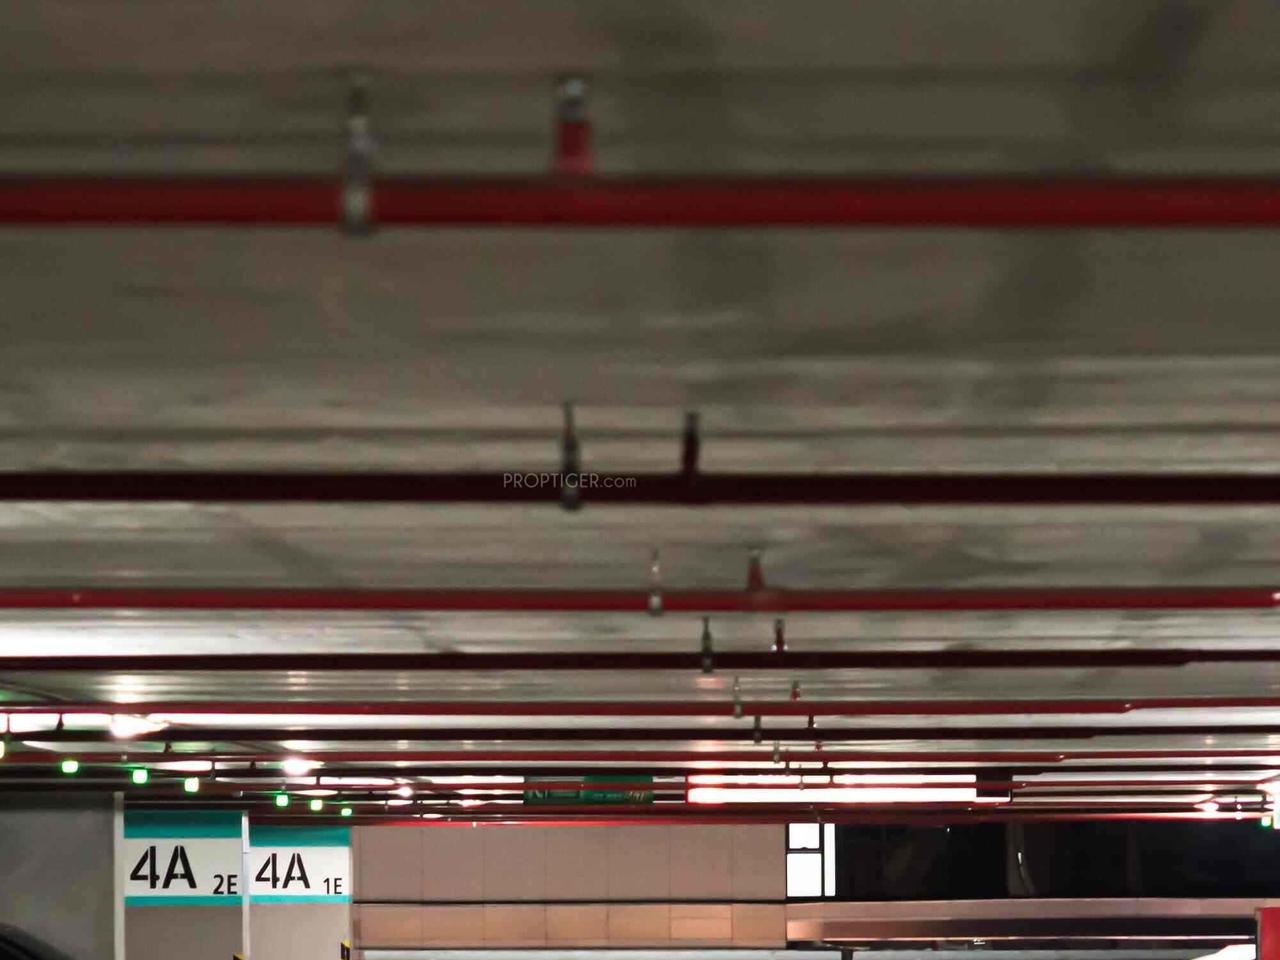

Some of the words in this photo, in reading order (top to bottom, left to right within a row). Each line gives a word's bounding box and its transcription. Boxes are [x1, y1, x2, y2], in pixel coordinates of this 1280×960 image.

[130, 846, 197, 889] 4A
[213, 874, 238, 895] 2E
[255, 853, 311, 889] 4A
[323, 877, 343, 895] 1E
